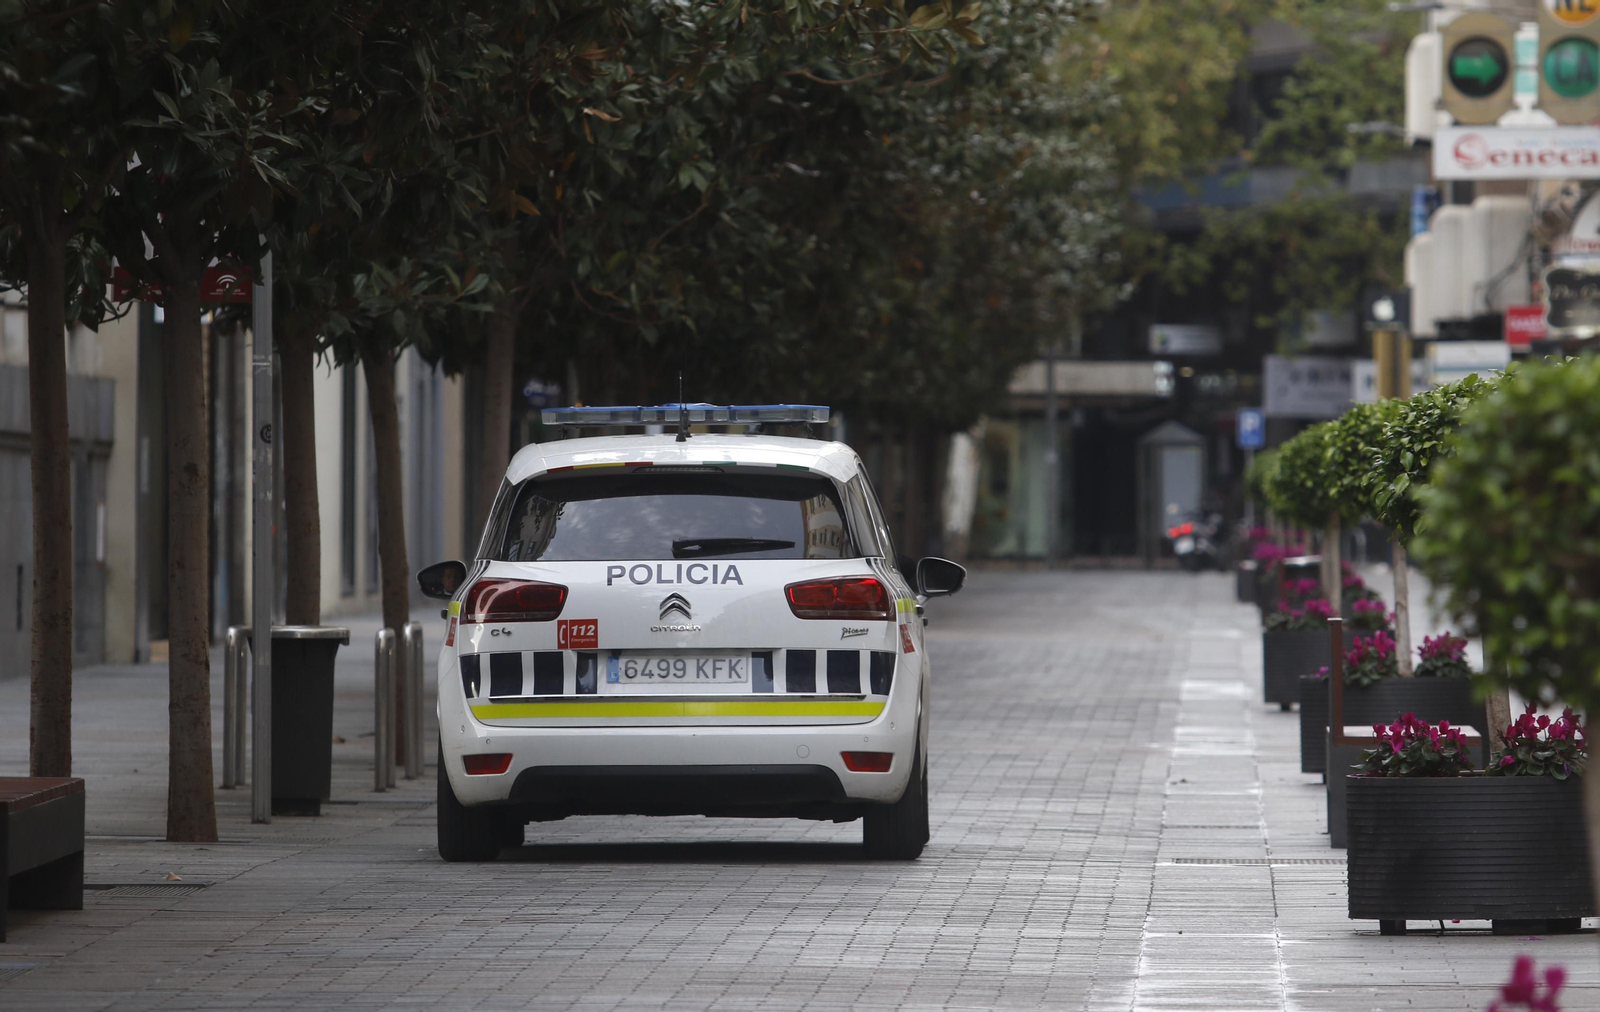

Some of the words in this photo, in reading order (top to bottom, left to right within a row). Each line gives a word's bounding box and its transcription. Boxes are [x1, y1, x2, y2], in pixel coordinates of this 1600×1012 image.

[1453, 133, 1599, 170] Seneca
[606, 563, 744, 586] POLICIA
[490, 627, 512, 637] C4
[571, 624, 596, 636] 112
[624, 648, 687, 680] 6499
[696, 648, 742, 679] KFK
